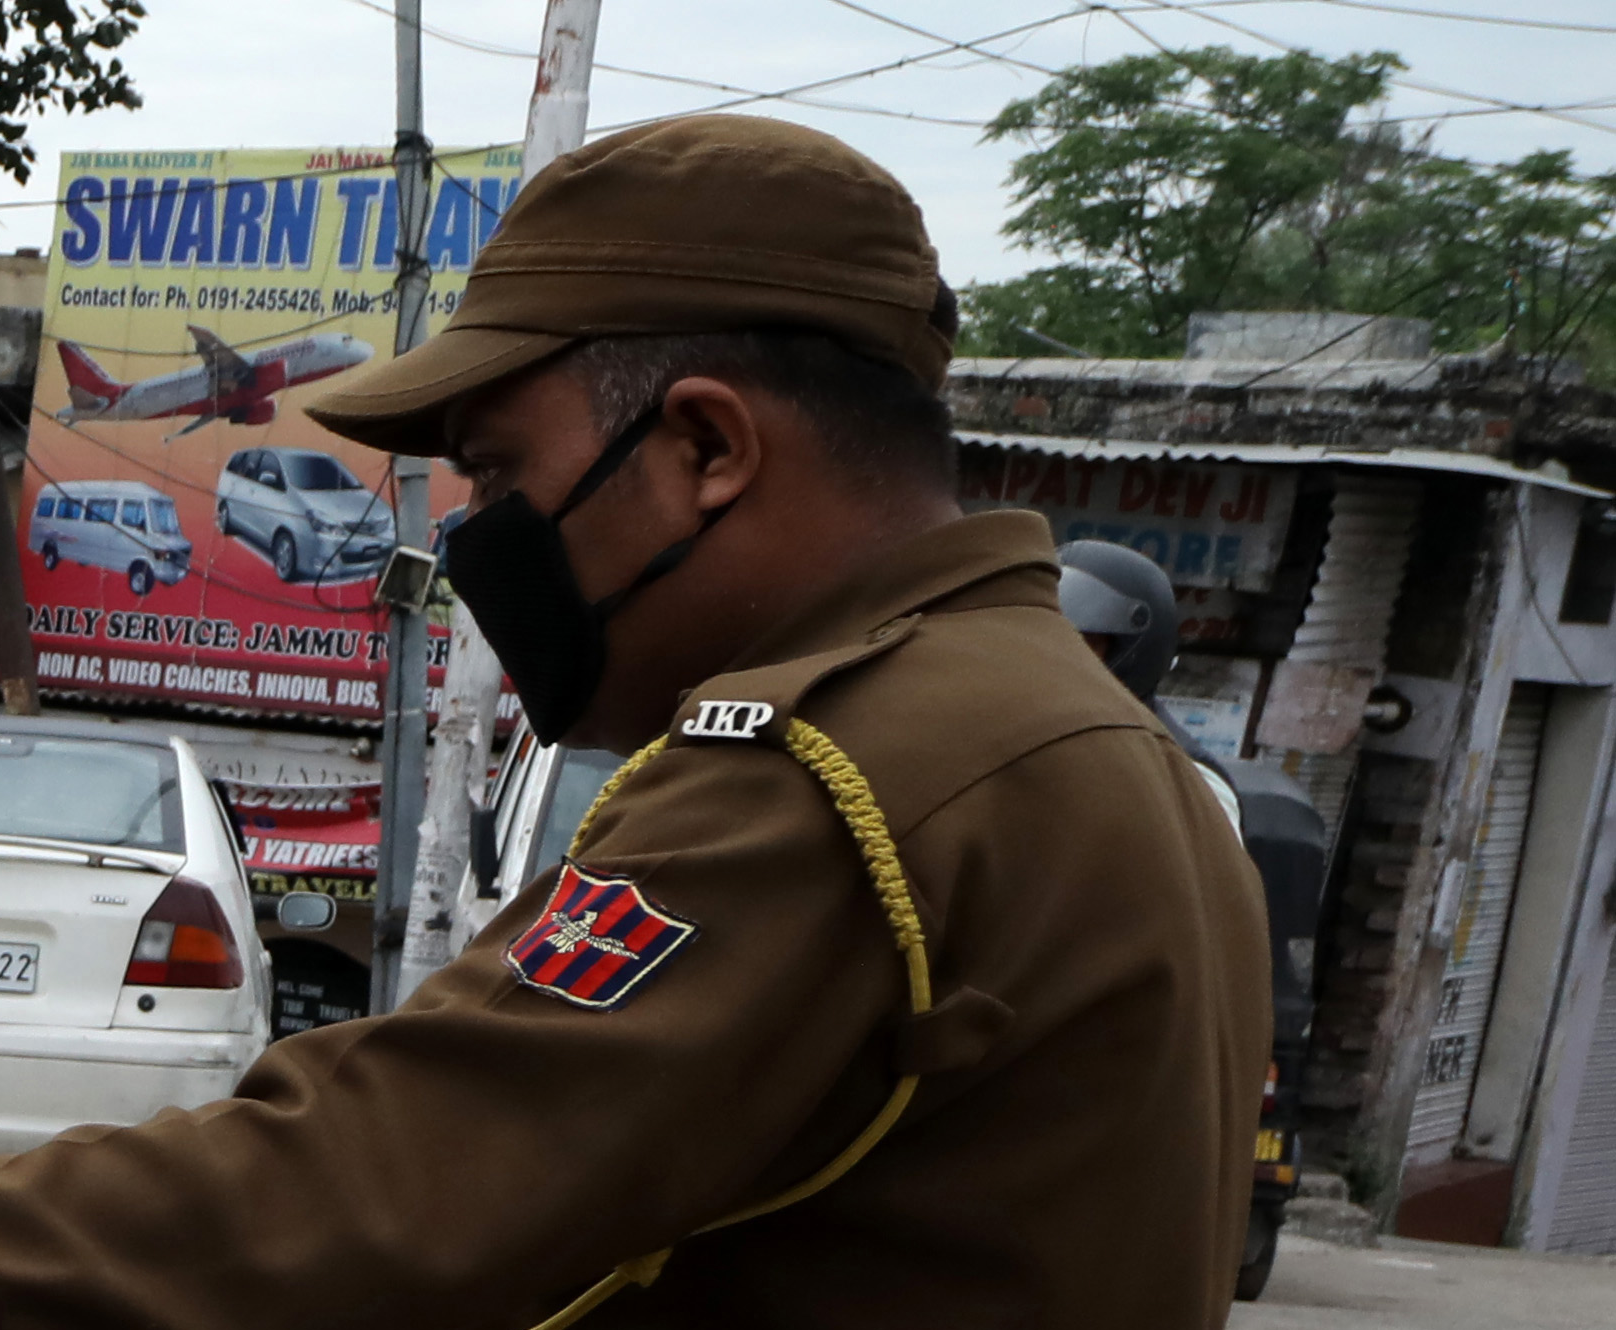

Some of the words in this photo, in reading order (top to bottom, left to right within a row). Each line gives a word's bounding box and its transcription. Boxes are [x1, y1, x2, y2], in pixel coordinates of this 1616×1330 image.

[305, 152, 334, 170] JAI
[338, 152, 386, 169] MATA
[61, 173, 322, 272] SWARN
[61, 282, 127, 308] Contact
[131, 286, 161, 309] for:
[165, 285, 192, 310] Ph.
[1118, 462, 1218, 520] DEV
[1219, 473, 1273, 524] JI
[106, 609, 241, 650] SERVICE:
[244, 621, 360, 660] JAMMU
[365, 630, 390, 663] T
[37, 651, 75, 680] NON
[75, 654, 105, 684] AC,
[108, 657, 162, 689] VIDEO
[163, 662, 254, 698] COACHES,
[255, 671, 332, 706] INNOVA,
[335, 678, 381, 711] BUS,
[681, 699, 776, 739] JKP
